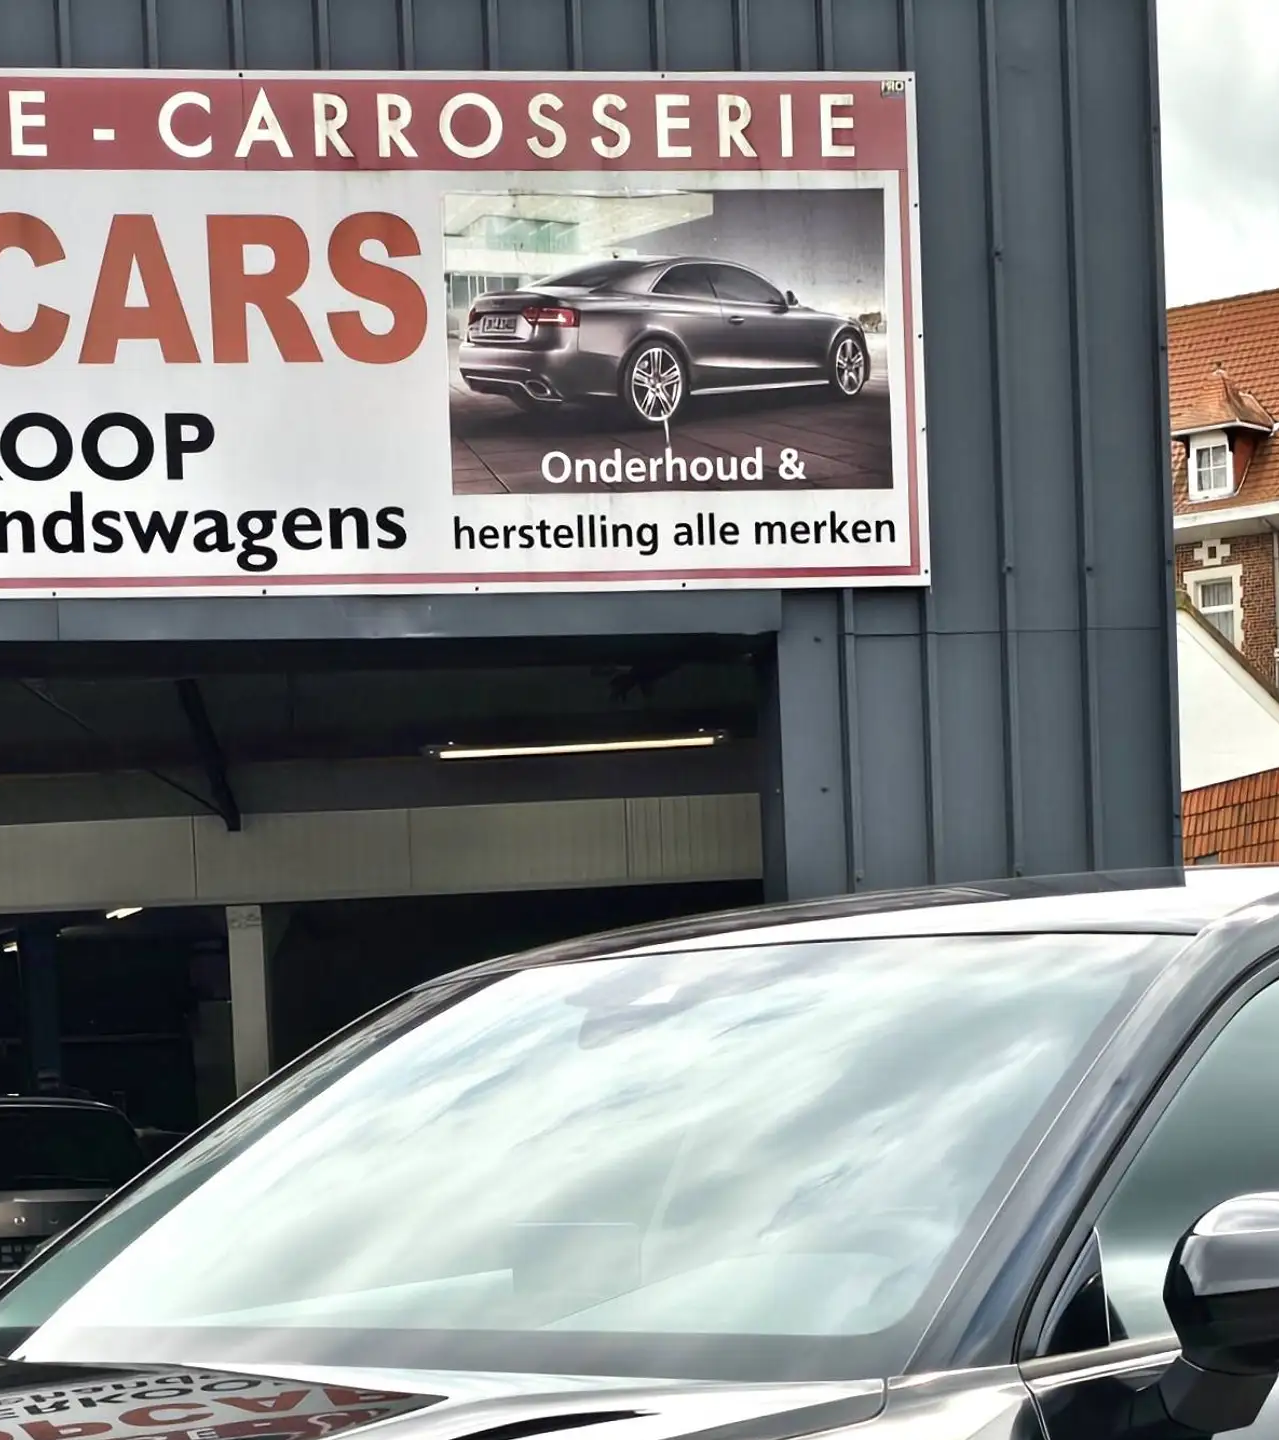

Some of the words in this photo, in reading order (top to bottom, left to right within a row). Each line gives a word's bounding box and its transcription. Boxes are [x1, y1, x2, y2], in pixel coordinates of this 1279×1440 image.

[158, 87, 856, 160] CARROSSERIE
[541, 446, 764, 484] Onderhoud
[778, 449, 807, 481] &
[453, 514, 659, 555] herstelling
[674, 512, 739, 549] alle
[754, 511, 897, 547] merken
